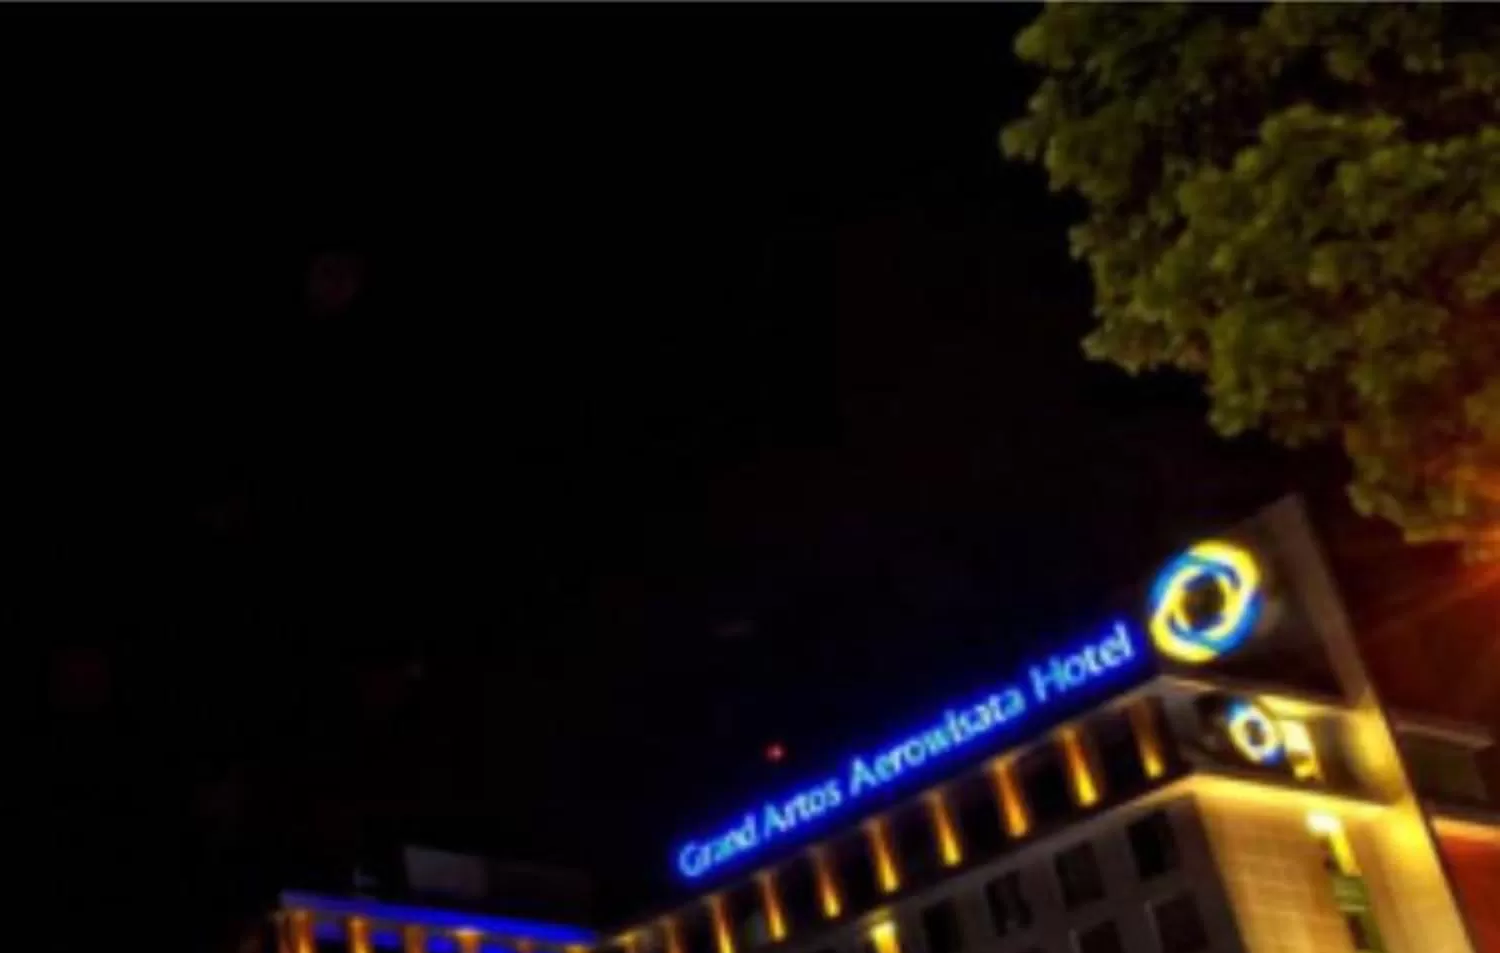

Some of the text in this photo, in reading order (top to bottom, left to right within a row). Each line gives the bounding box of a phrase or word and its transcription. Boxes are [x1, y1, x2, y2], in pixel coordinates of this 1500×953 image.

[678, 621, 1136, 877] Grand Artos Aerowisata Hotel
